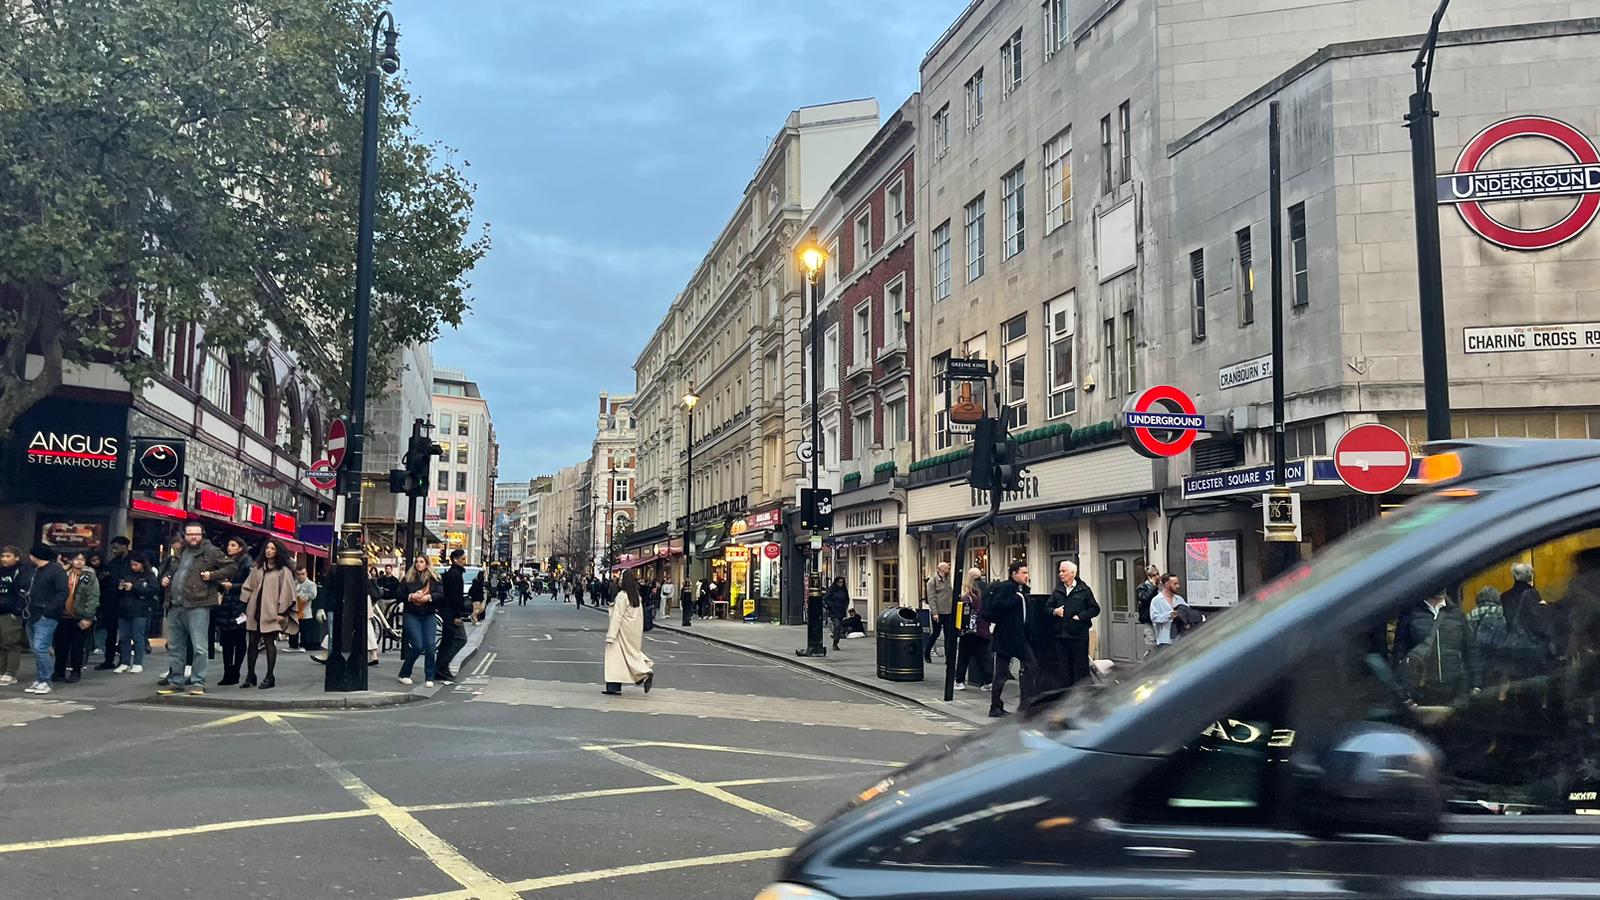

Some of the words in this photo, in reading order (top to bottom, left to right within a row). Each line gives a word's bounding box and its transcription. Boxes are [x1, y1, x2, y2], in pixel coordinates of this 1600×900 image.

[1452, 166, 1600, 199] UNDERGROUND
[1468, 333, 1526, 350] CHARING
[1533, 331, 1577, 347] CROSS
[1221, 365, 1259, 386] CRANBOURN
[1129, 415, 1202, 427] UNDERGROUND
[29, 431, 118, 456] ANGUS
[28, 455, 117, 470] STEAKHOUSE
[139, 478, 177, 488] ANGUS
[1187, 477, 1224, 492] LEICESTER
[1228, 471, 1260, 486] SQUARE
[1265, 466, 1302, 481] STION
[971, 476, 1039, 507] BREASER
[846, 508, 883, 528] BREWMASTER
